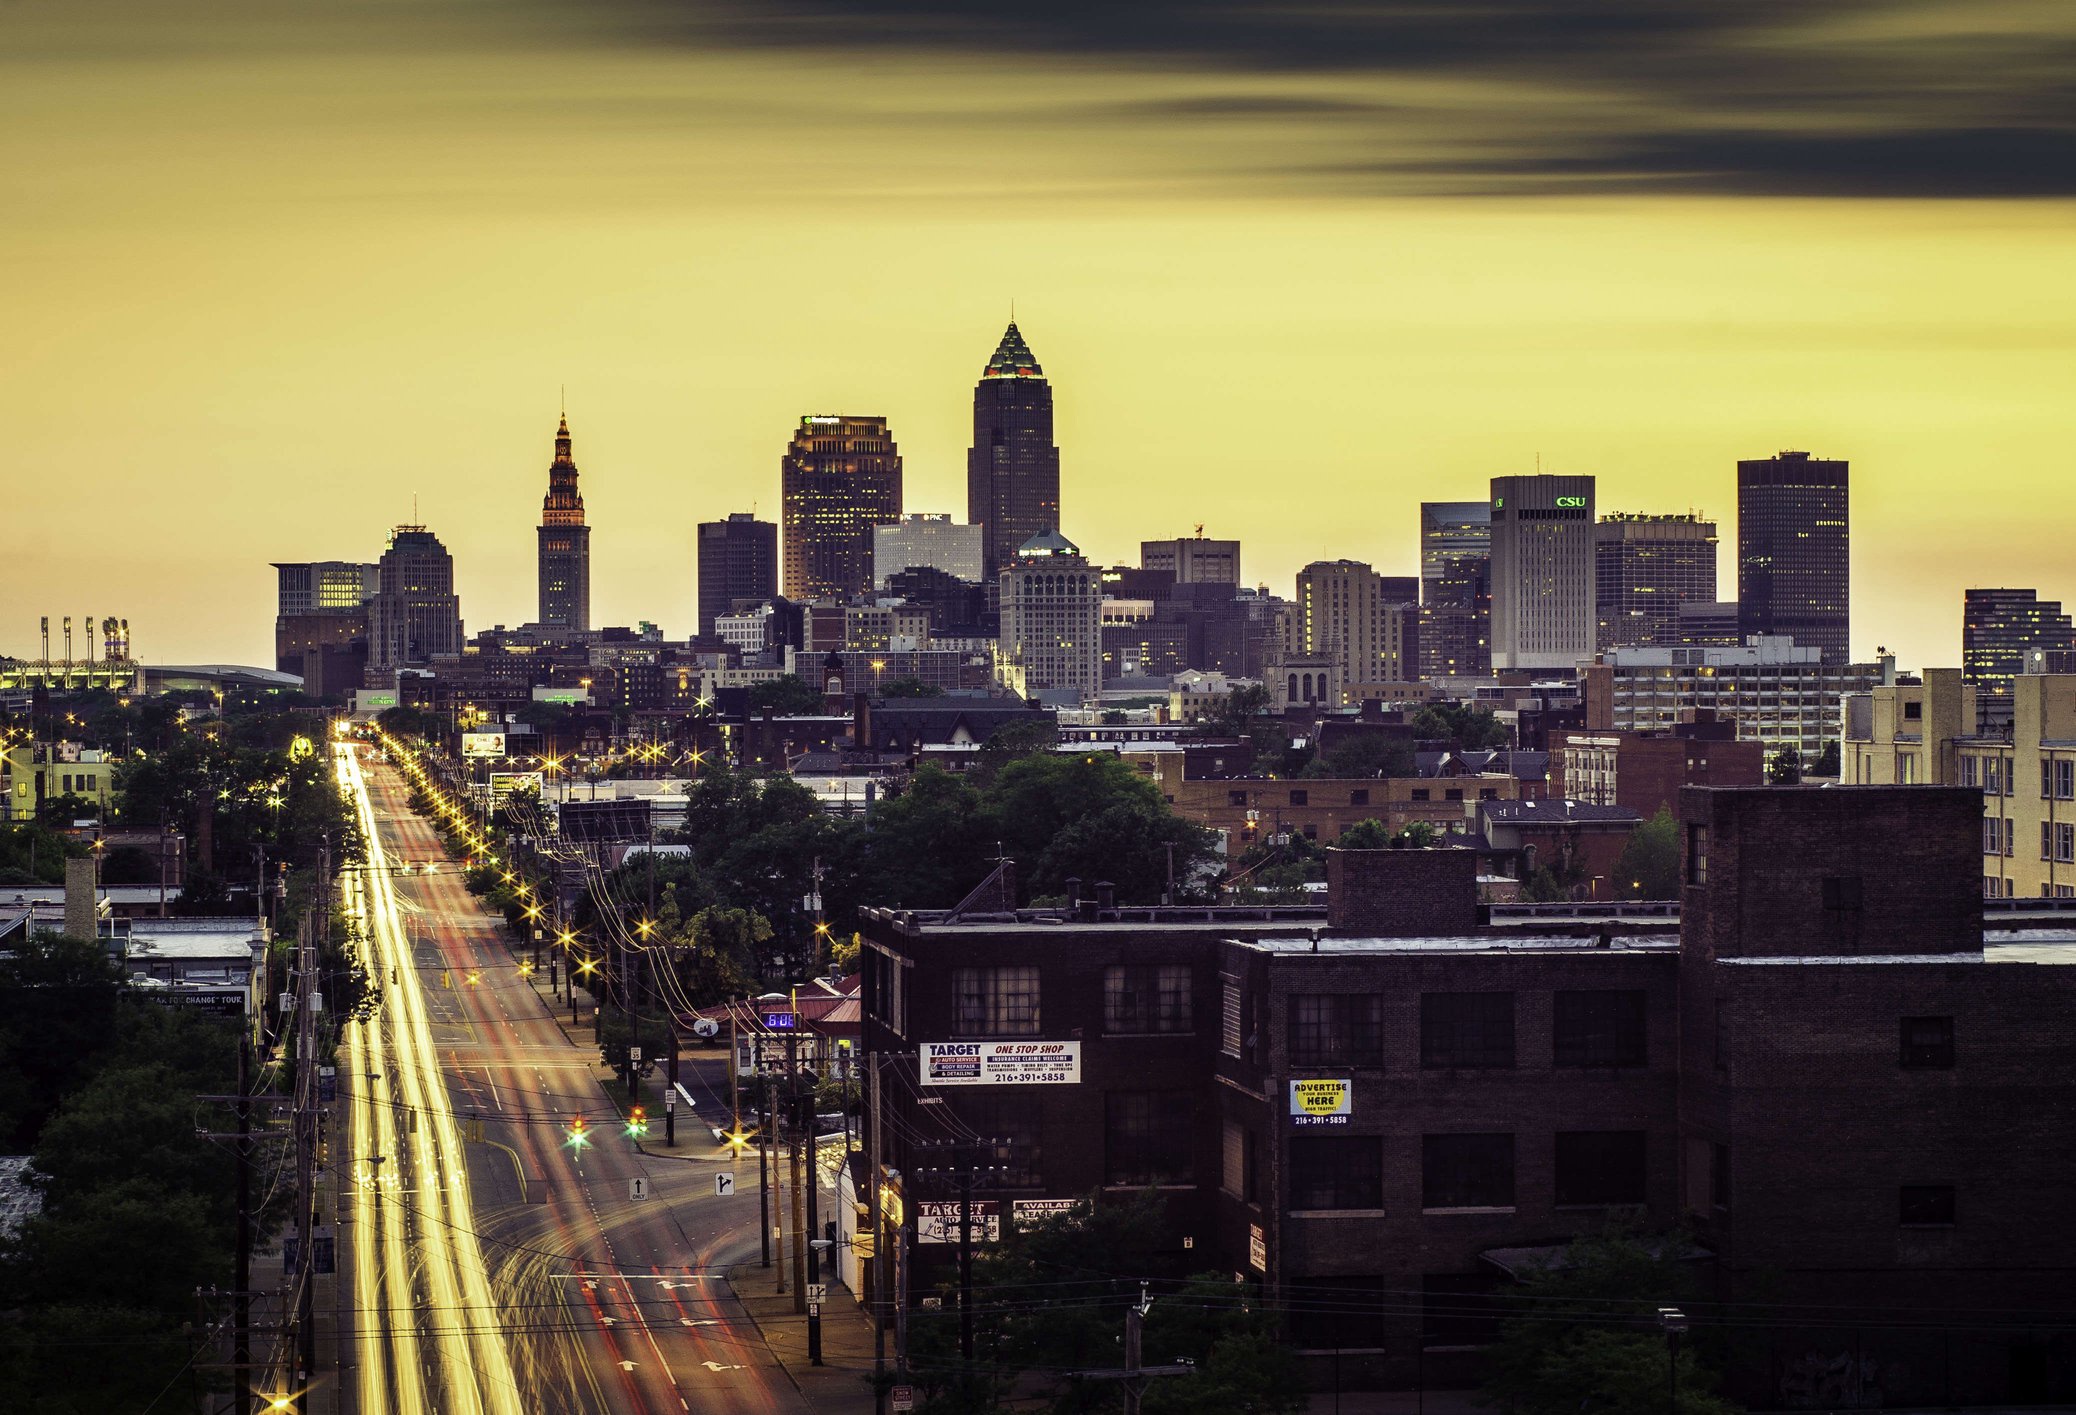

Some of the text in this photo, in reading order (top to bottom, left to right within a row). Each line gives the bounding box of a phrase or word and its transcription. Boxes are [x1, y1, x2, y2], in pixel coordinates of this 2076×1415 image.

[1556, 497, 1585, 507] CSU
[222, 996, 242, 1004] TOUR
[930, 1044, 981, 1056] TARGET
[995, 1045, 1064, 1054] ONE STOP SHOP
[917, 1096, 943, 1104] EXHIBITS
[1307, 1097, 1334, 1105] HERE
[1023, 1210, 1054, 1218] LEASE
